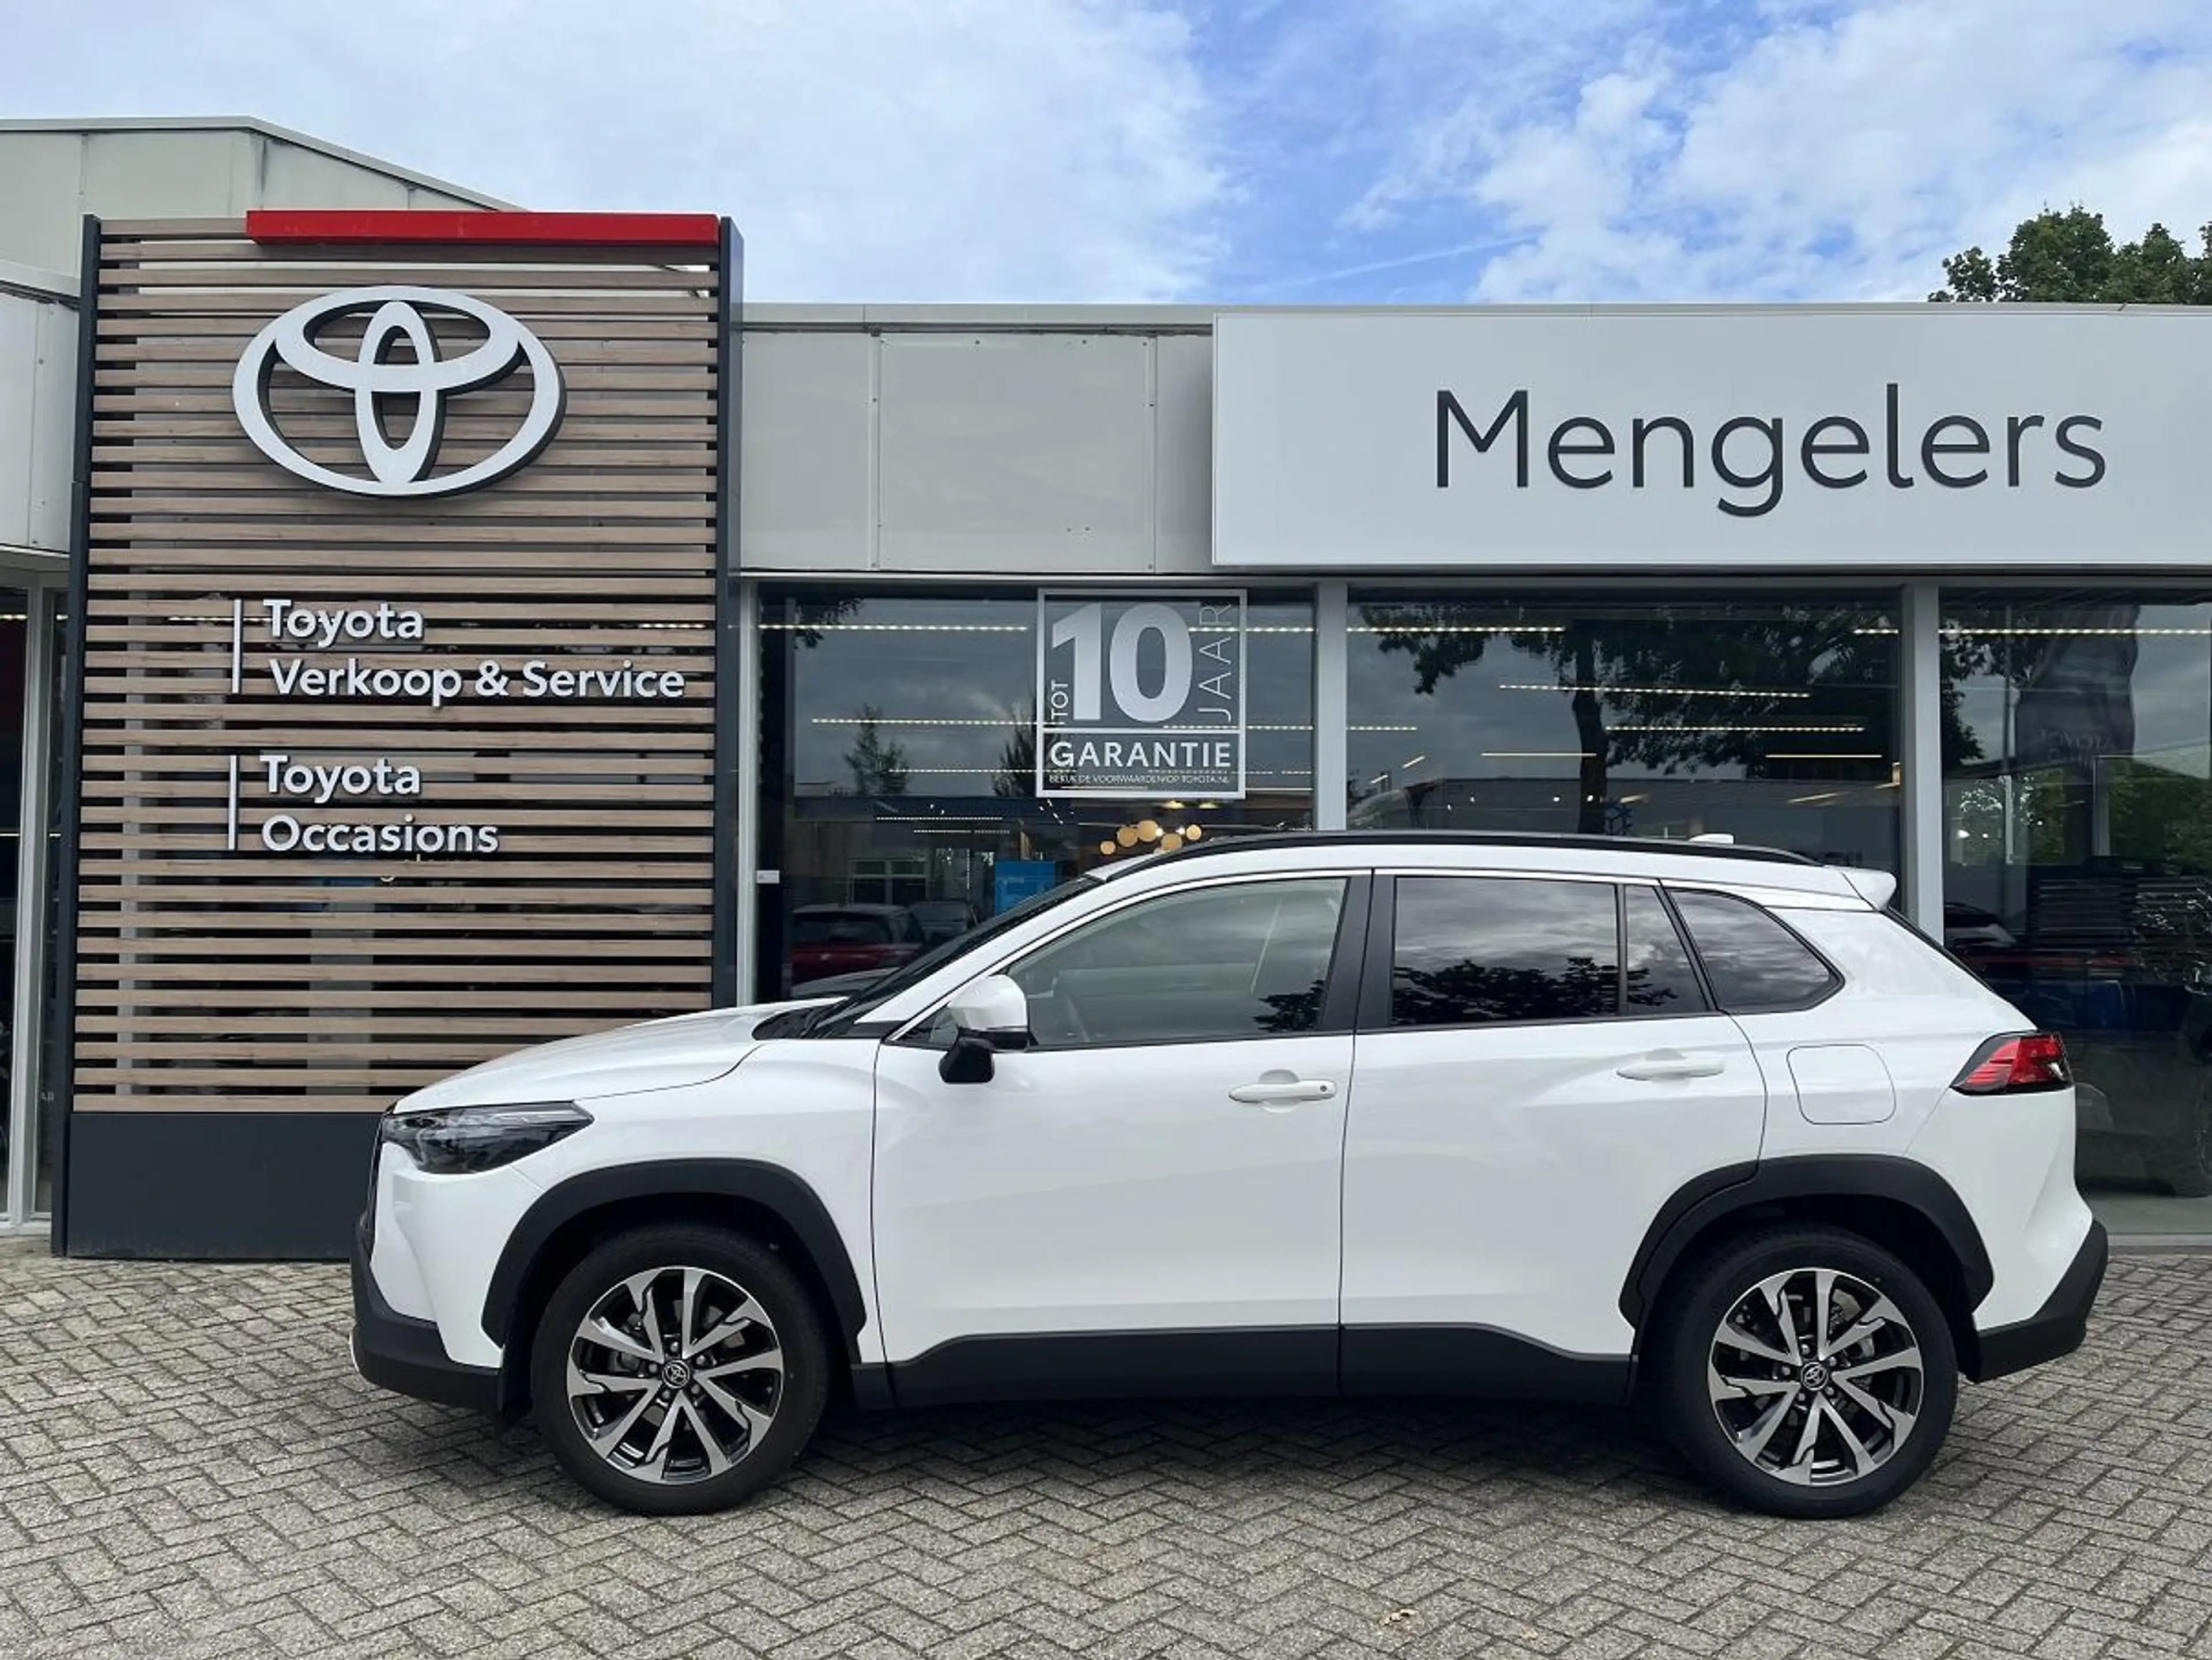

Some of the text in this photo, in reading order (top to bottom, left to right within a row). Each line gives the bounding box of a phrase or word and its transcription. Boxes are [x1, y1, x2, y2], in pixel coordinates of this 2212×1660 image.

[1436, 383, 2107, 517] Mengelers
[263, 599, 424, 647] Toyota
[269, 658, 685, 707] Verkoop & Service
[1052, 602, 1193, 722] 10
[1197, 603, 1232, 722] JAAR
[1050, 680, 1069, 720] TOT
[259, 754, 421, 803] Toyota
[1050, 741, 1231, 768] GARANTIE
[261, 813, 500, 853] Occasions
